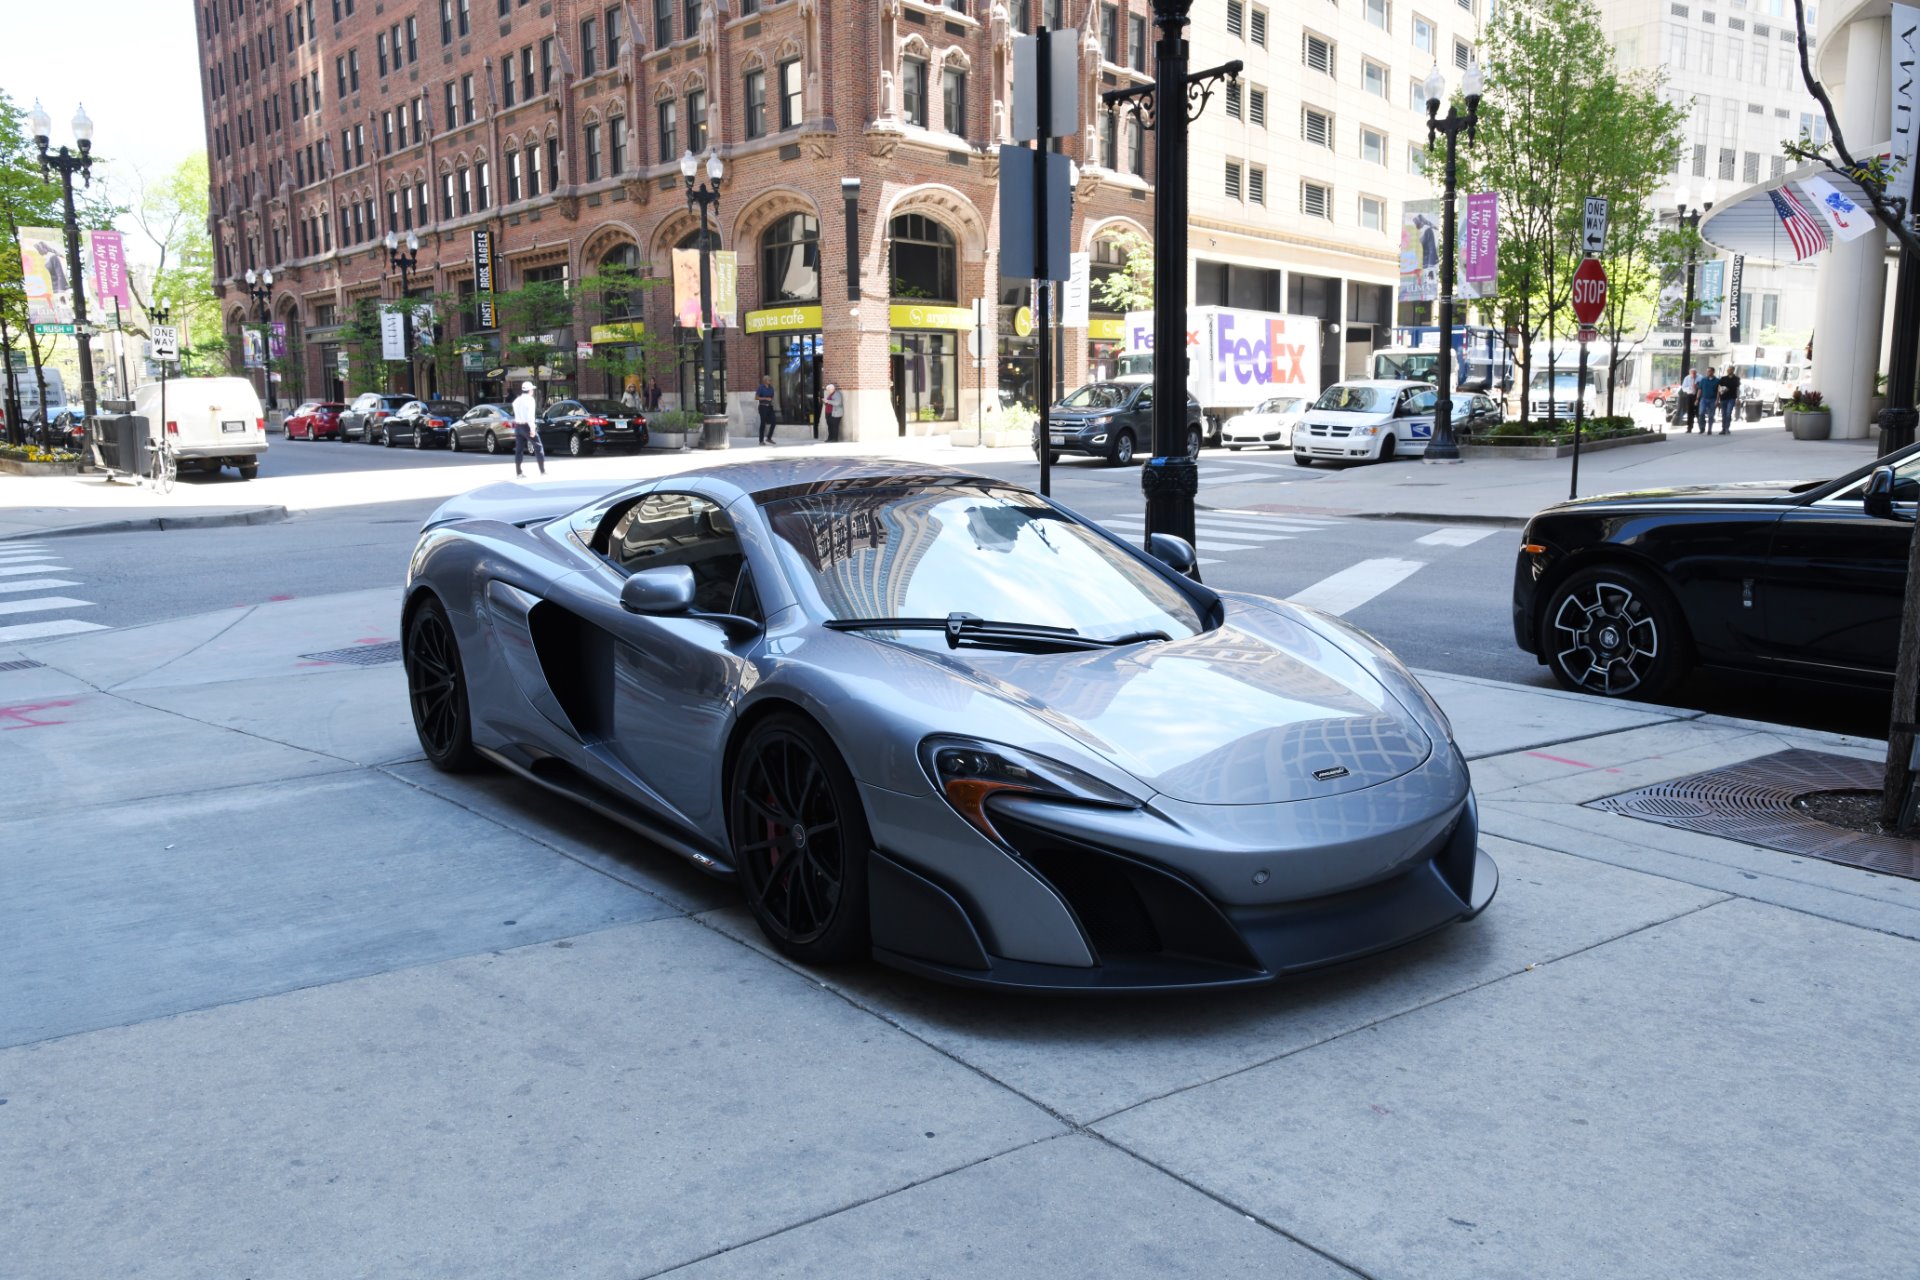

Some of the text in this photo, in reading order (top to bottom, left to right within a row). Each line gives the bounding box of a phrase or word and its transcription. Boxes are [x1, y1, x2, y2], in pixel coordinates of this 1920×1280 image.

[1482, 209, 1492, 227] Her
[1587, 201, 1605, 216] ONE
[1586, 217, 1604, 231] WAY
[1469, 210, 1480, 265] My Dreams
[96, 243, 106, 259] My
[108, 244, 118, 264] Her
[478, 232, 488, 264] BAGELS
[98, 259, 109, 294] Dreams
[1574, 278, 1606, 304] STOP
[1730, 254, 1741, 328] NORDSTROM rack
[780, 308, 805, 325] café
[43, 325, 65, 333] RUSH
[154, 328, 174, 338] ONE
[1133, 327, 1200, 350] Fex
[154, 337, 174, 347] WAY
[1217, 313, 1306, 386] FedEx
